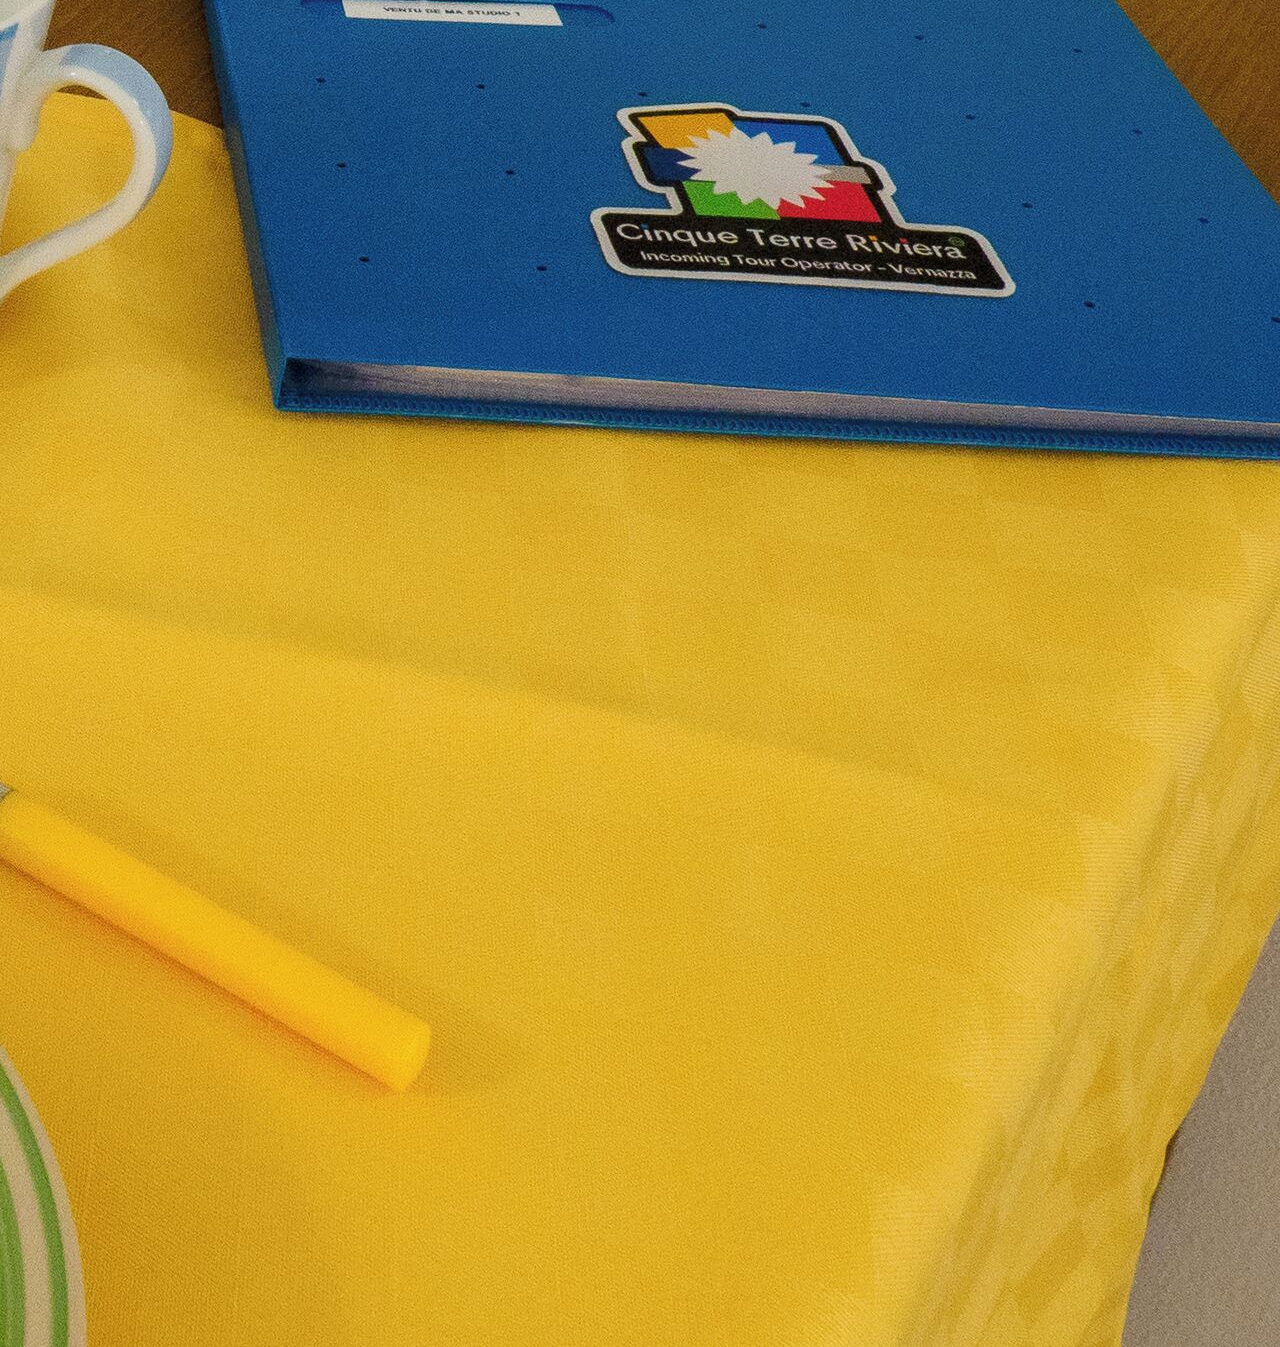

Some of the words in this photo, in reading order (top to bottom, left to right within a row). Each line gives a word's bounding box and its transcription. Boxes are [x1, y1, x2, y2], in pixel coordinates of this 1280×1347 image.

[616, 222, 739, 247] Cinque
[746, 228, 838, 250] Terre
[845, 233, 966, 259] Riviera
[640, 250, 730, 266] Incoming
[733, 254, 777, 267] Tour
[780, 257, 872, 272] Operator
[889, 263, 977, 280] Vernazza
